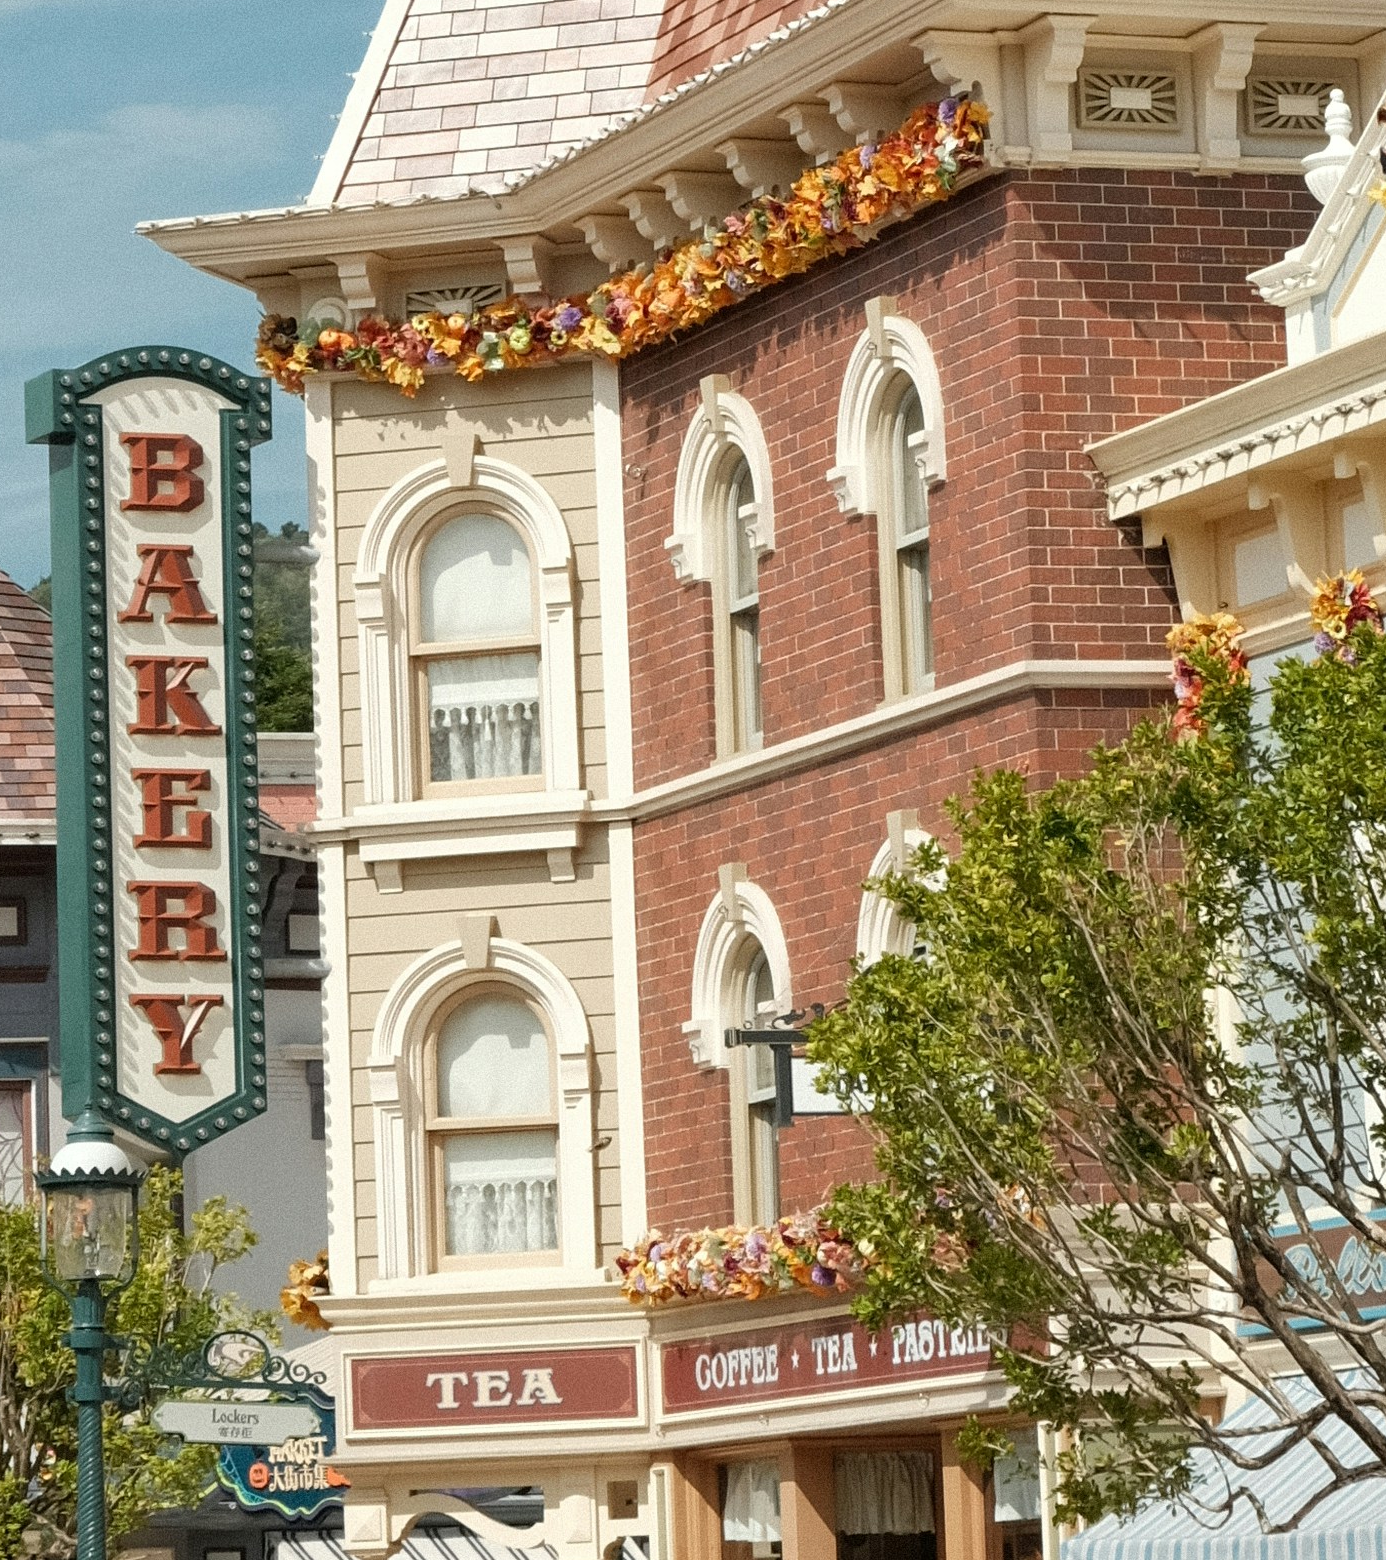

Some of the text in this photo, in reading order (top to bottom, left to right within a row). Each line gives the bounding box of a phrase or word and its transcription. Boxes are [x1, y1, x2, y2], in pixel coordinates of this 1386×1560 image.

[117, 432, 227, 1075] BAKERY
[695, 1344, 779, 1392] COFFEE
[811, 1333, 858, 1376] TEA
[426, 1367, 564, 1410] TEA
[212, 1408, 260, 1424] Lockers
